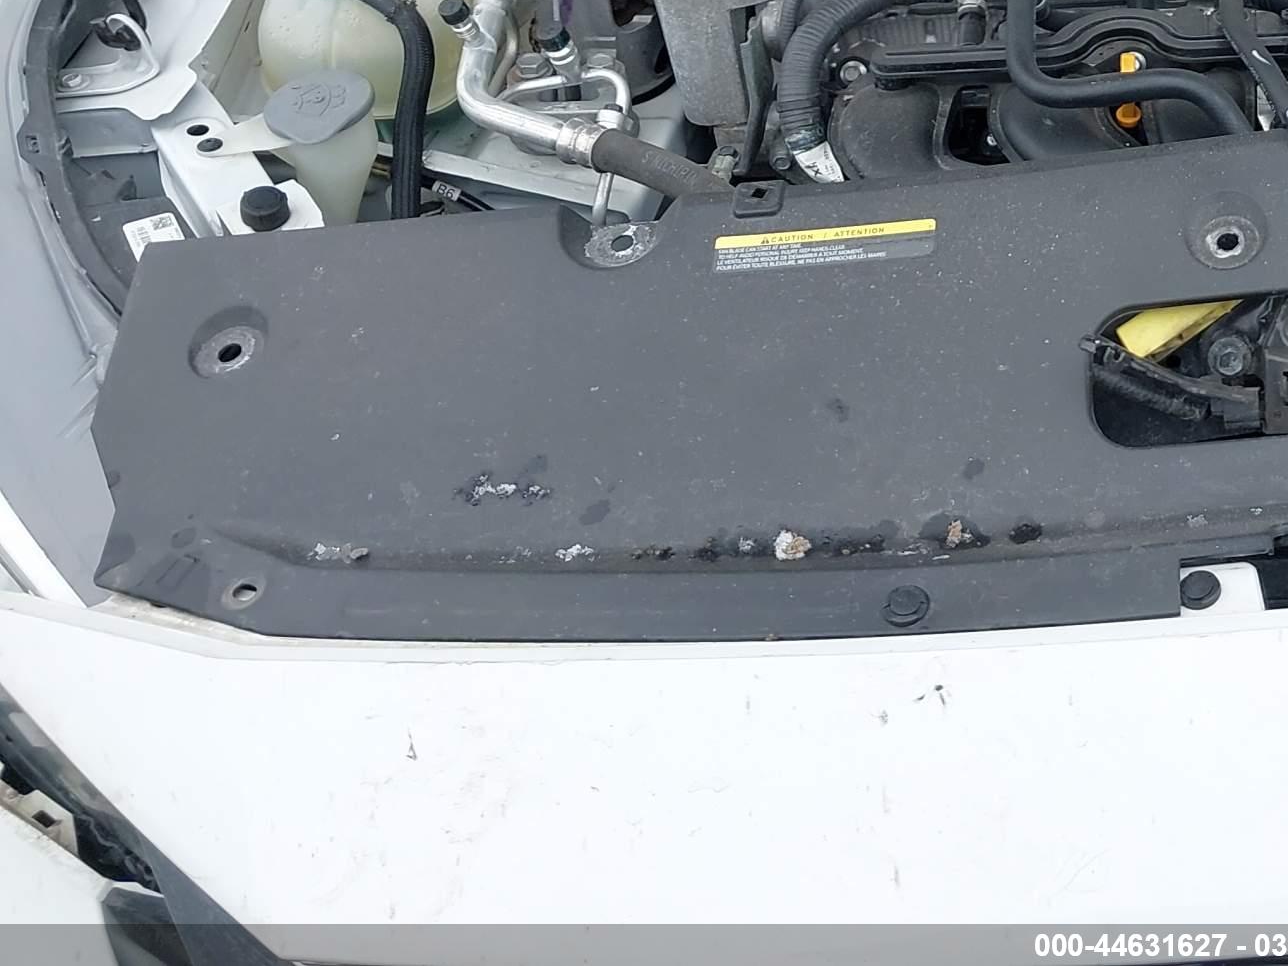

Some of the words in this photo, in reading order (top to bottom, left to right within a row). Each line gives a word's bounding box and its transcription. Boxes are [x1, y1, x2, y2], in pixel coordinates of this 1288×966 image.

[436, 183, 456, 199] B6
[771, 234, 814, 243] CAUTION
[833, 227, 885, 238] ATTENTION
